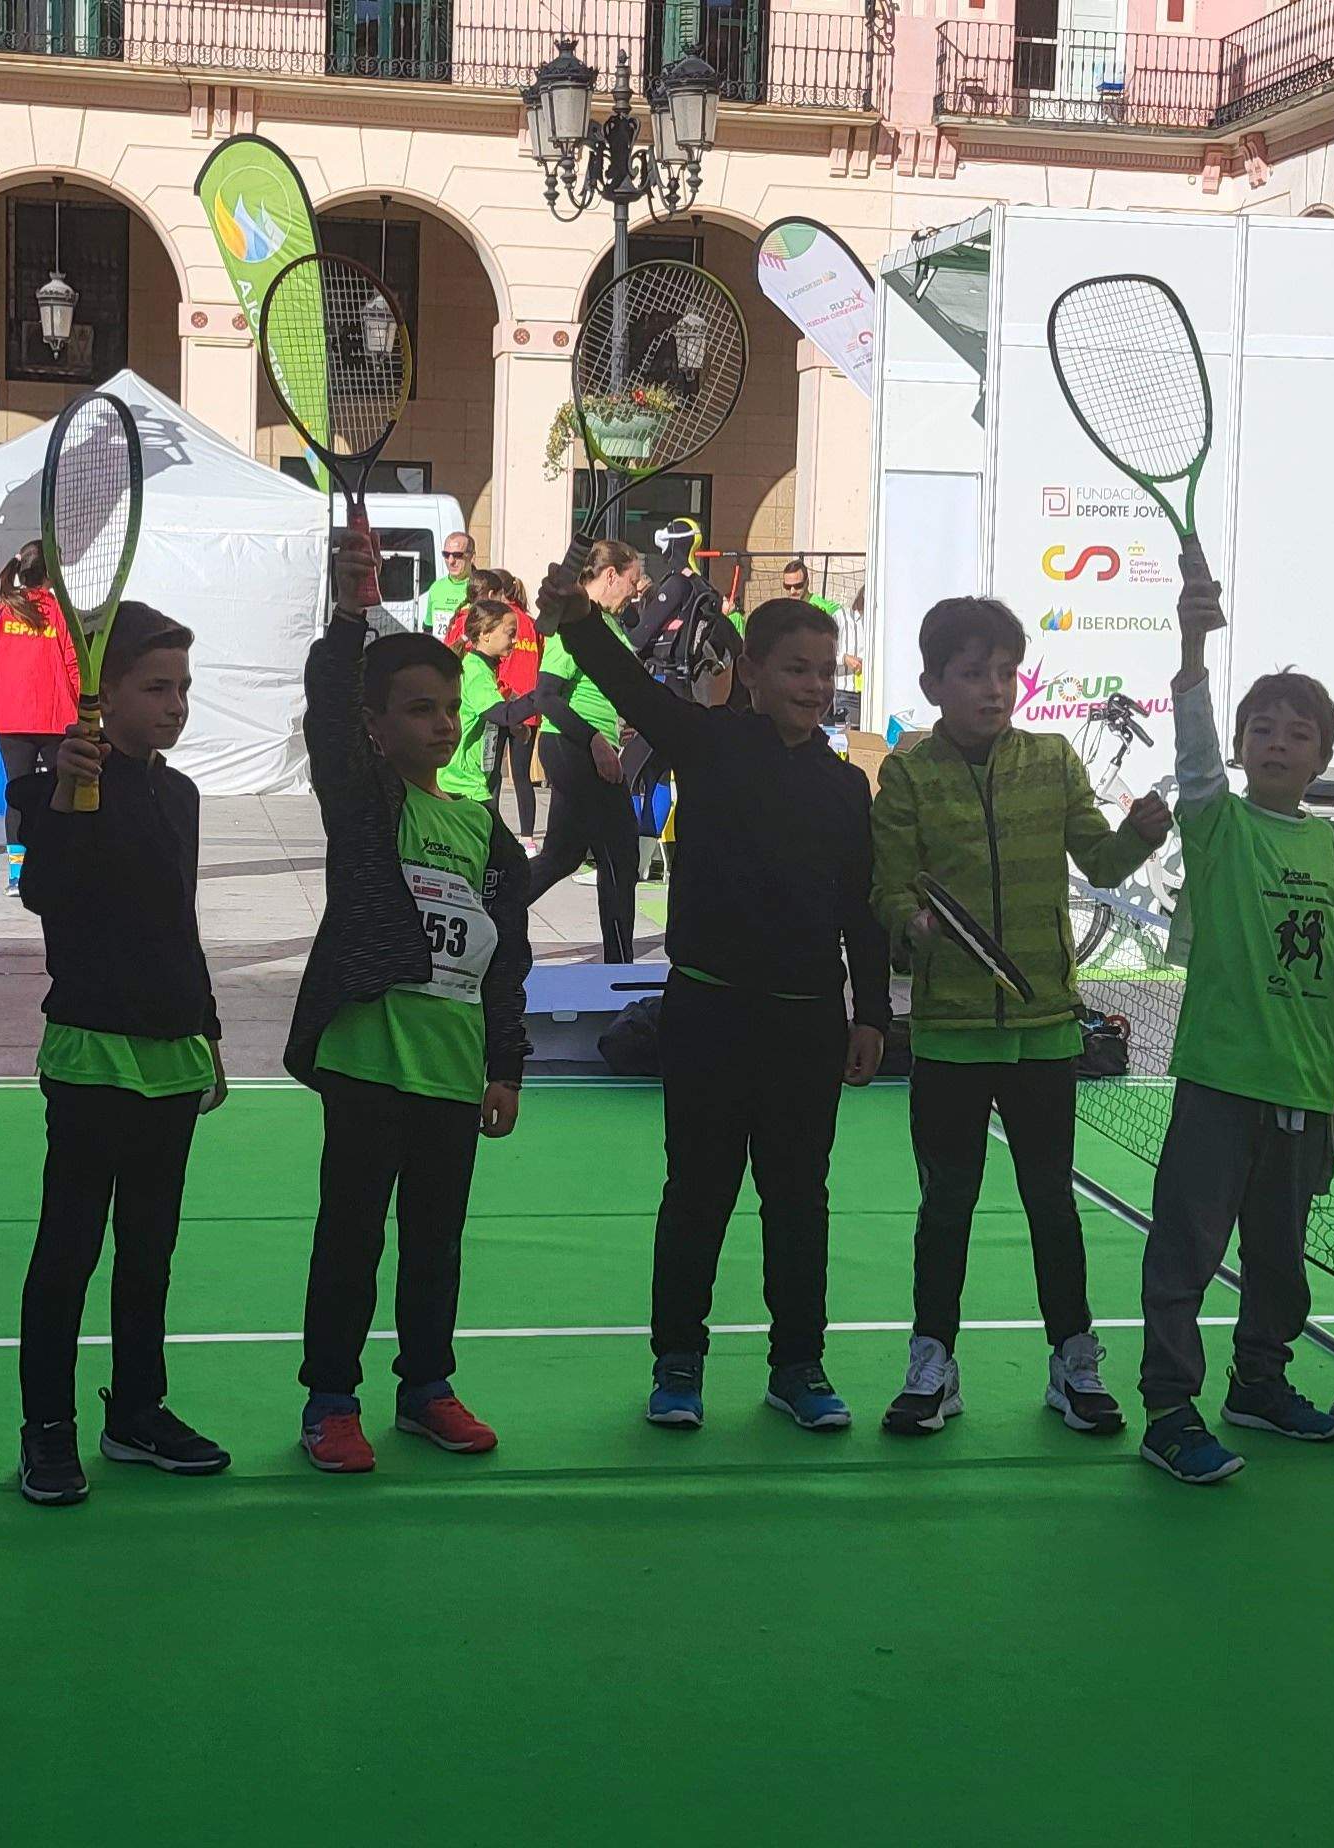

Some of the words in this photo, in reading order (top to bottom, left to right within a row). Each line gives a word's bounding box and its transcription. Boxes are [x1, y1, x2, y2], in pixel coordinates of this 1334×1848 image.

[1076, 486, 1149, 501] FUNDACIÓ
[1076, 505, 1129, 518] DEPORTE
[1133, 505, 1168, 519] JOVE
[1129, 559, 1159, 568] Consejo
[1129, 567, 1161, 576] Superior
[1128, 575, 1139, 583] de
[1140, 575, 1173, 584] Deportes
[1078, 616, 1173, 631] IBERDROLA
[422, 912, 469, 959] 53
